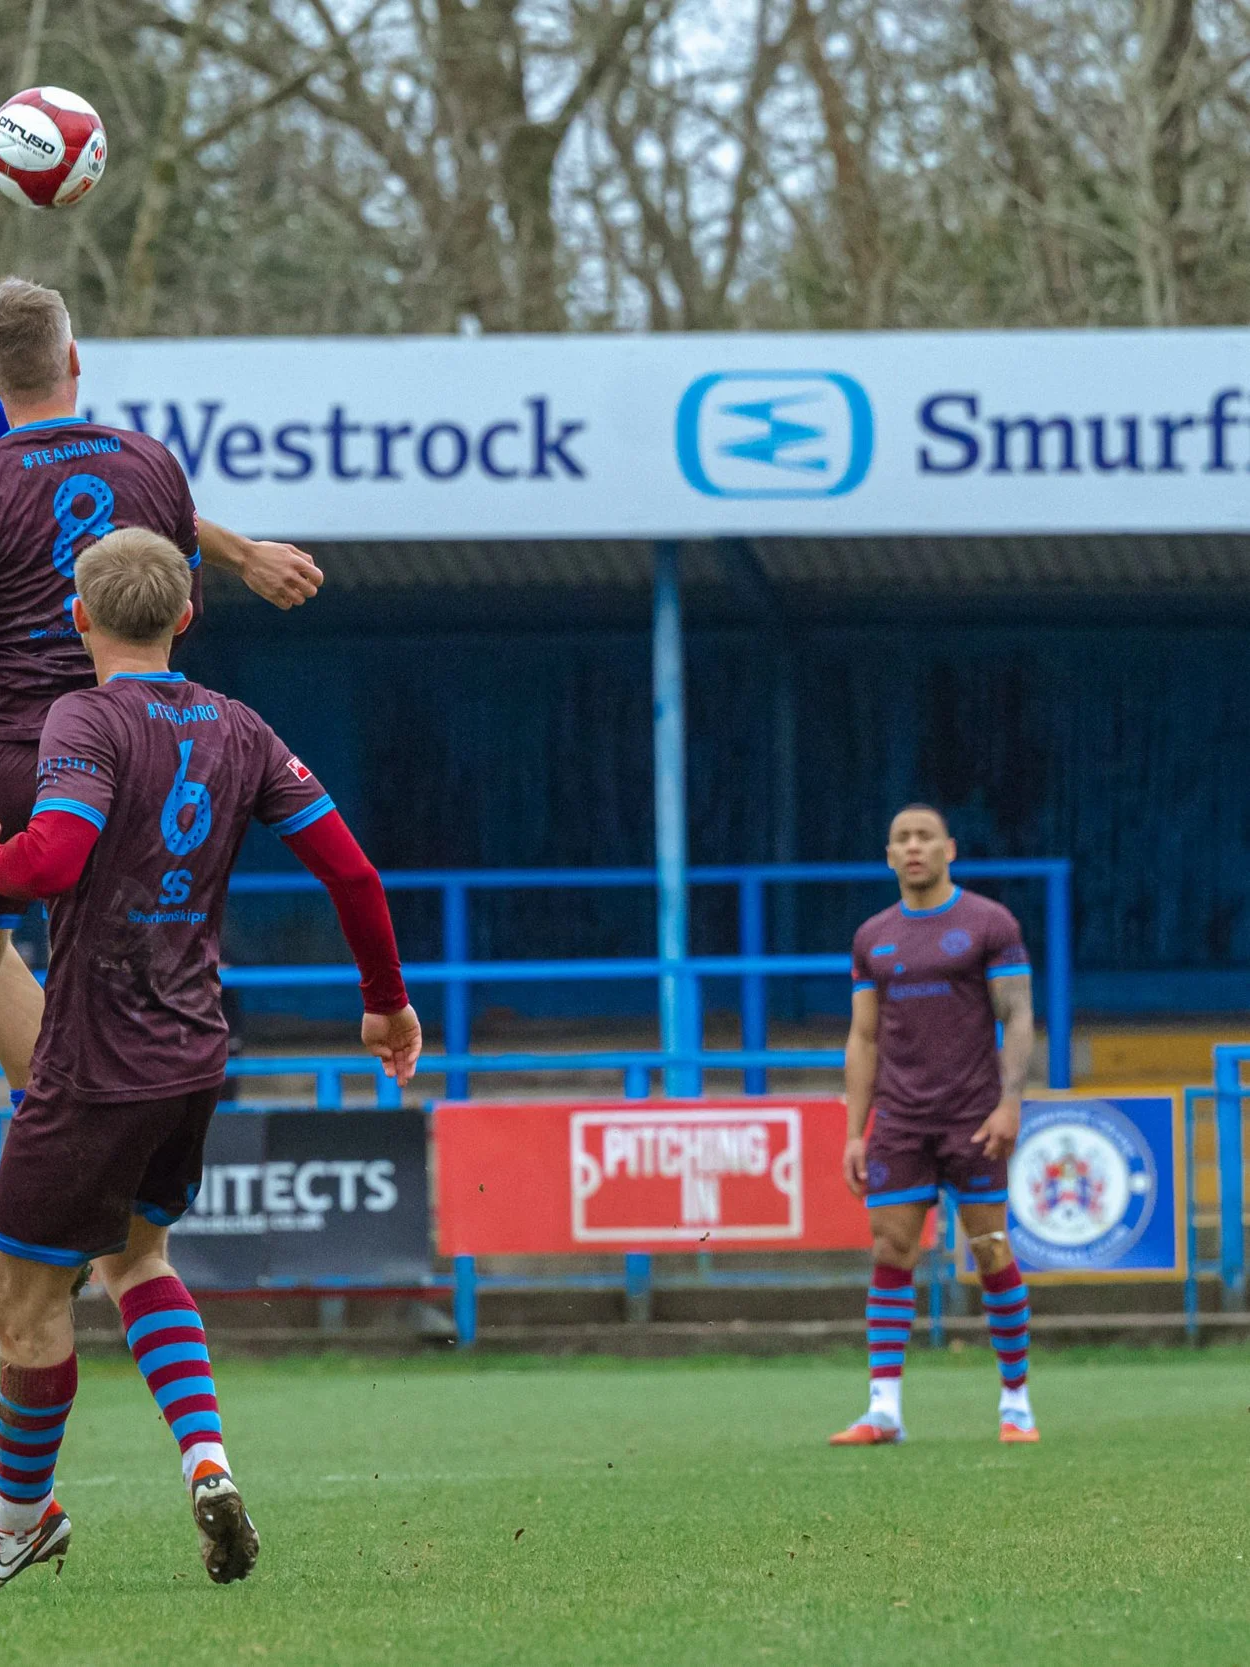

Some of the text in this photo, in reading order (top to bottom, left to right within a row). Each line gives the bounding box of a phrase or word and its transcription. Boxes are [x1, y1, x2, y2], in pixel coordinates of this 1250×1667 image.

[22, 437, 121, 470] #TEAMAVRO
[916, 386, 1250, 477] Smurf
[52, 473, 115, 578] 8
[160, 739, 212, 857] 6
[604, 1124, 768, 1178] PITCHING
[683, 1175, 721, 1224] IN
